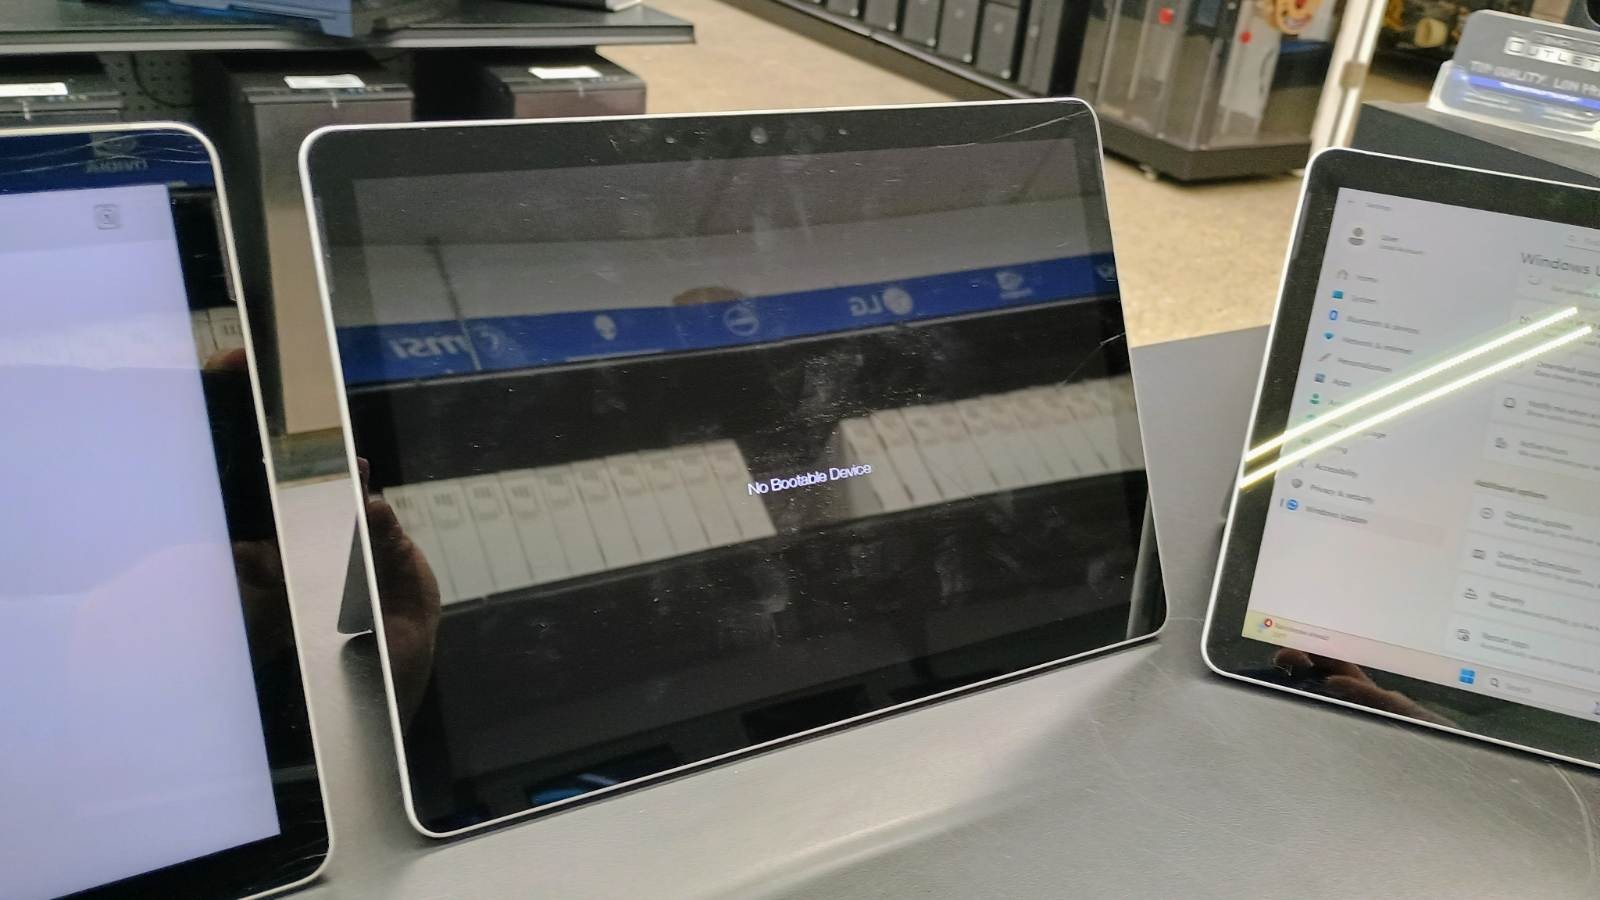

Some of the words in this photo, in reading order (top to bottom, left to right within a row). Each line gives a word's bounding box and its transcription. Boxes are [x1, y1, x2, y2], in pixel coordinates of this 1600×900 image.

[1520, 252, 1592, 275] Windows
[747, 481, 769, 496] No
[770, 471, 828, 492] Bootable
[829, 463, 872, 481] Device
